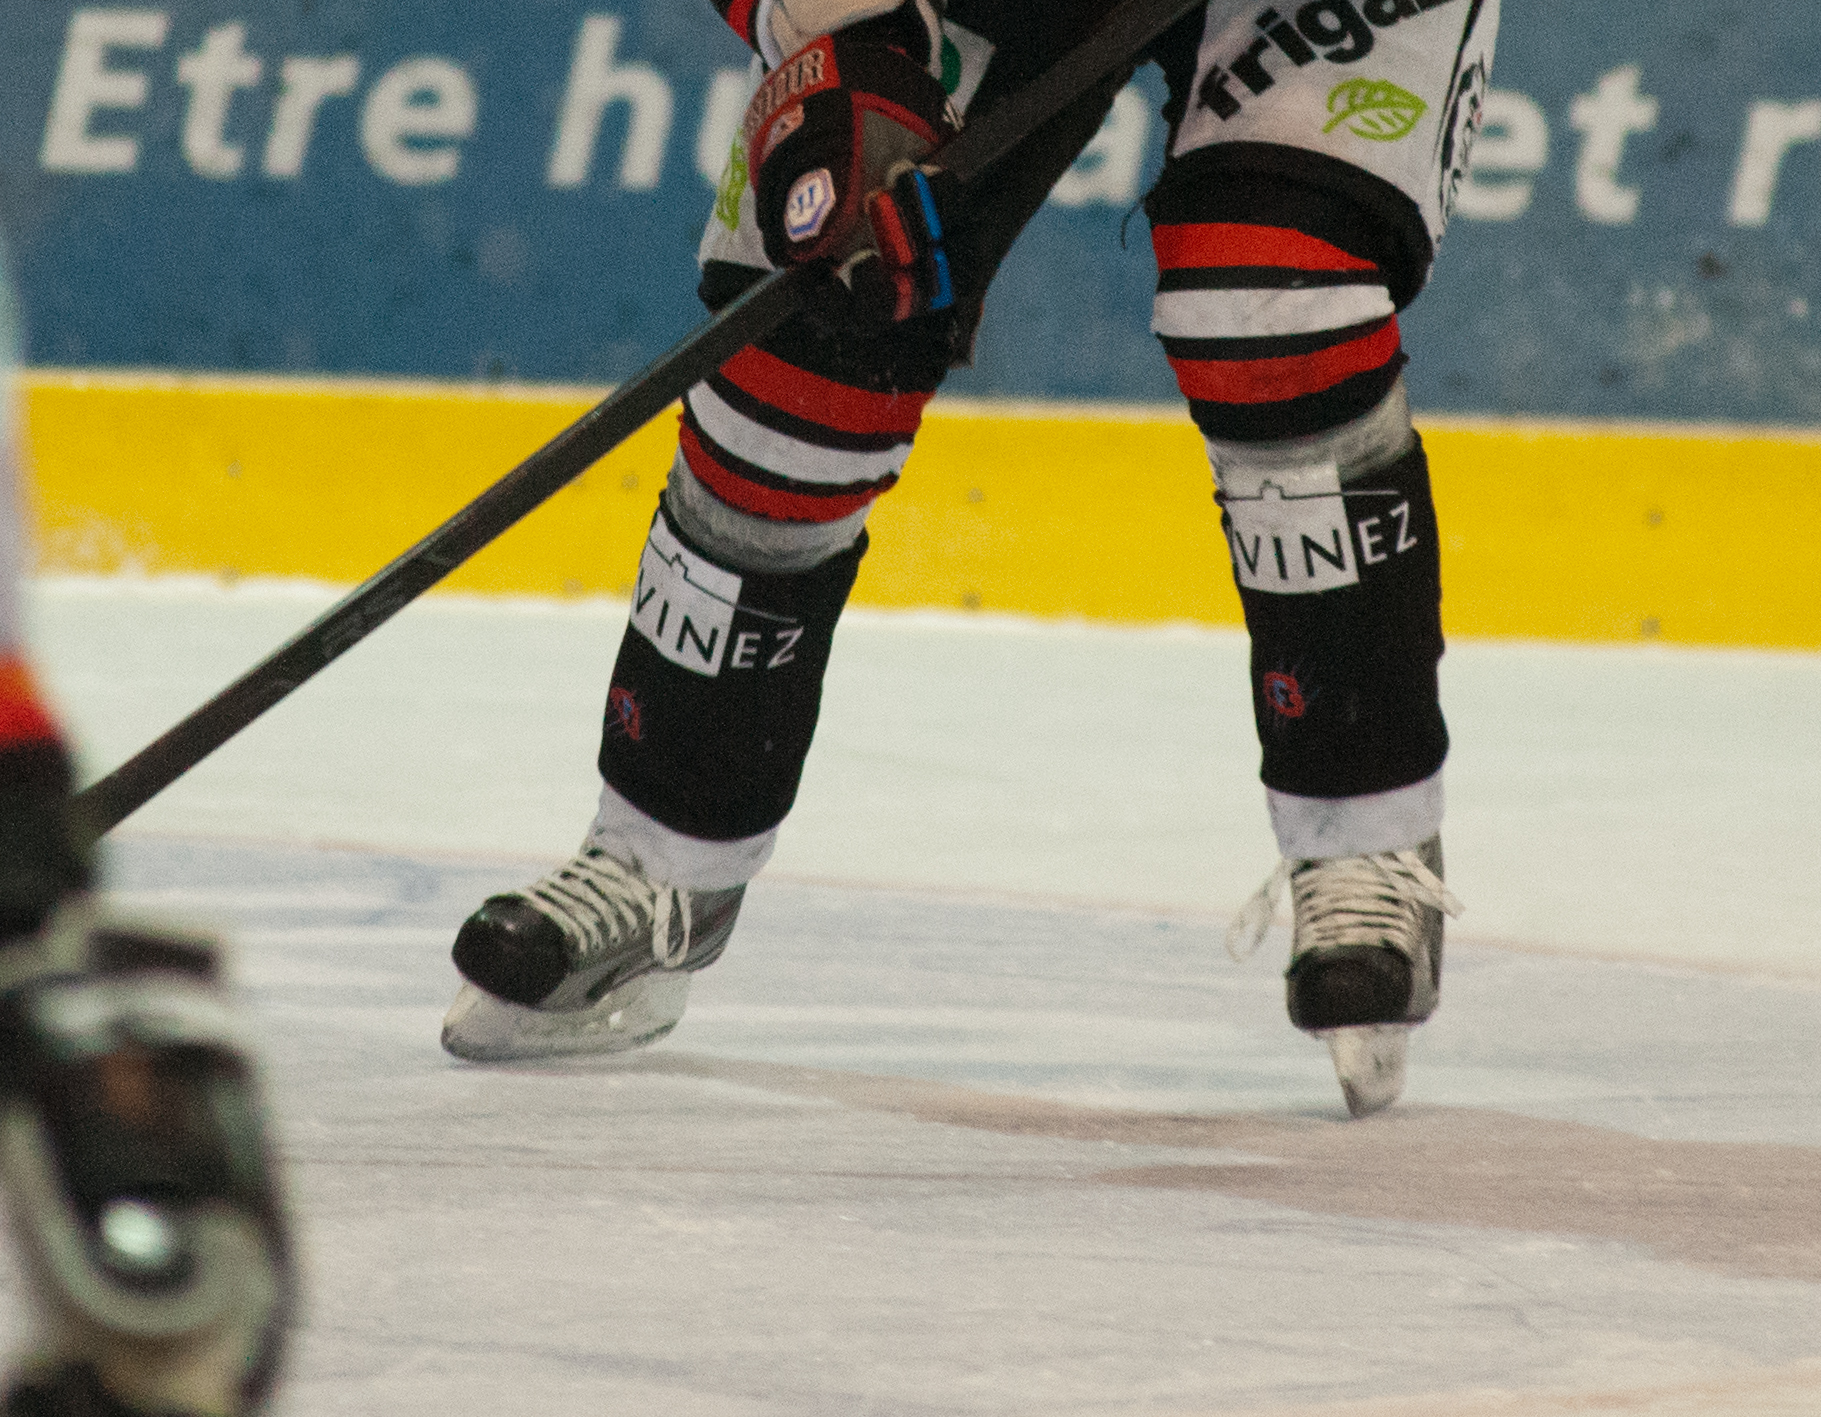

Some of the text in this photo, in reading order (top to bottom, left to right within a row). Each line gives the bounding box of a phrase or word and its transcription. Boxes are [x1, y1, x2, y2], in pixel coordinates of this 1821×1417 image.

[40, 8, 478, 187] Etre
[1234, 501, 1417, 582] VINEZ
[635, 567, 804, 670] VINEZ
